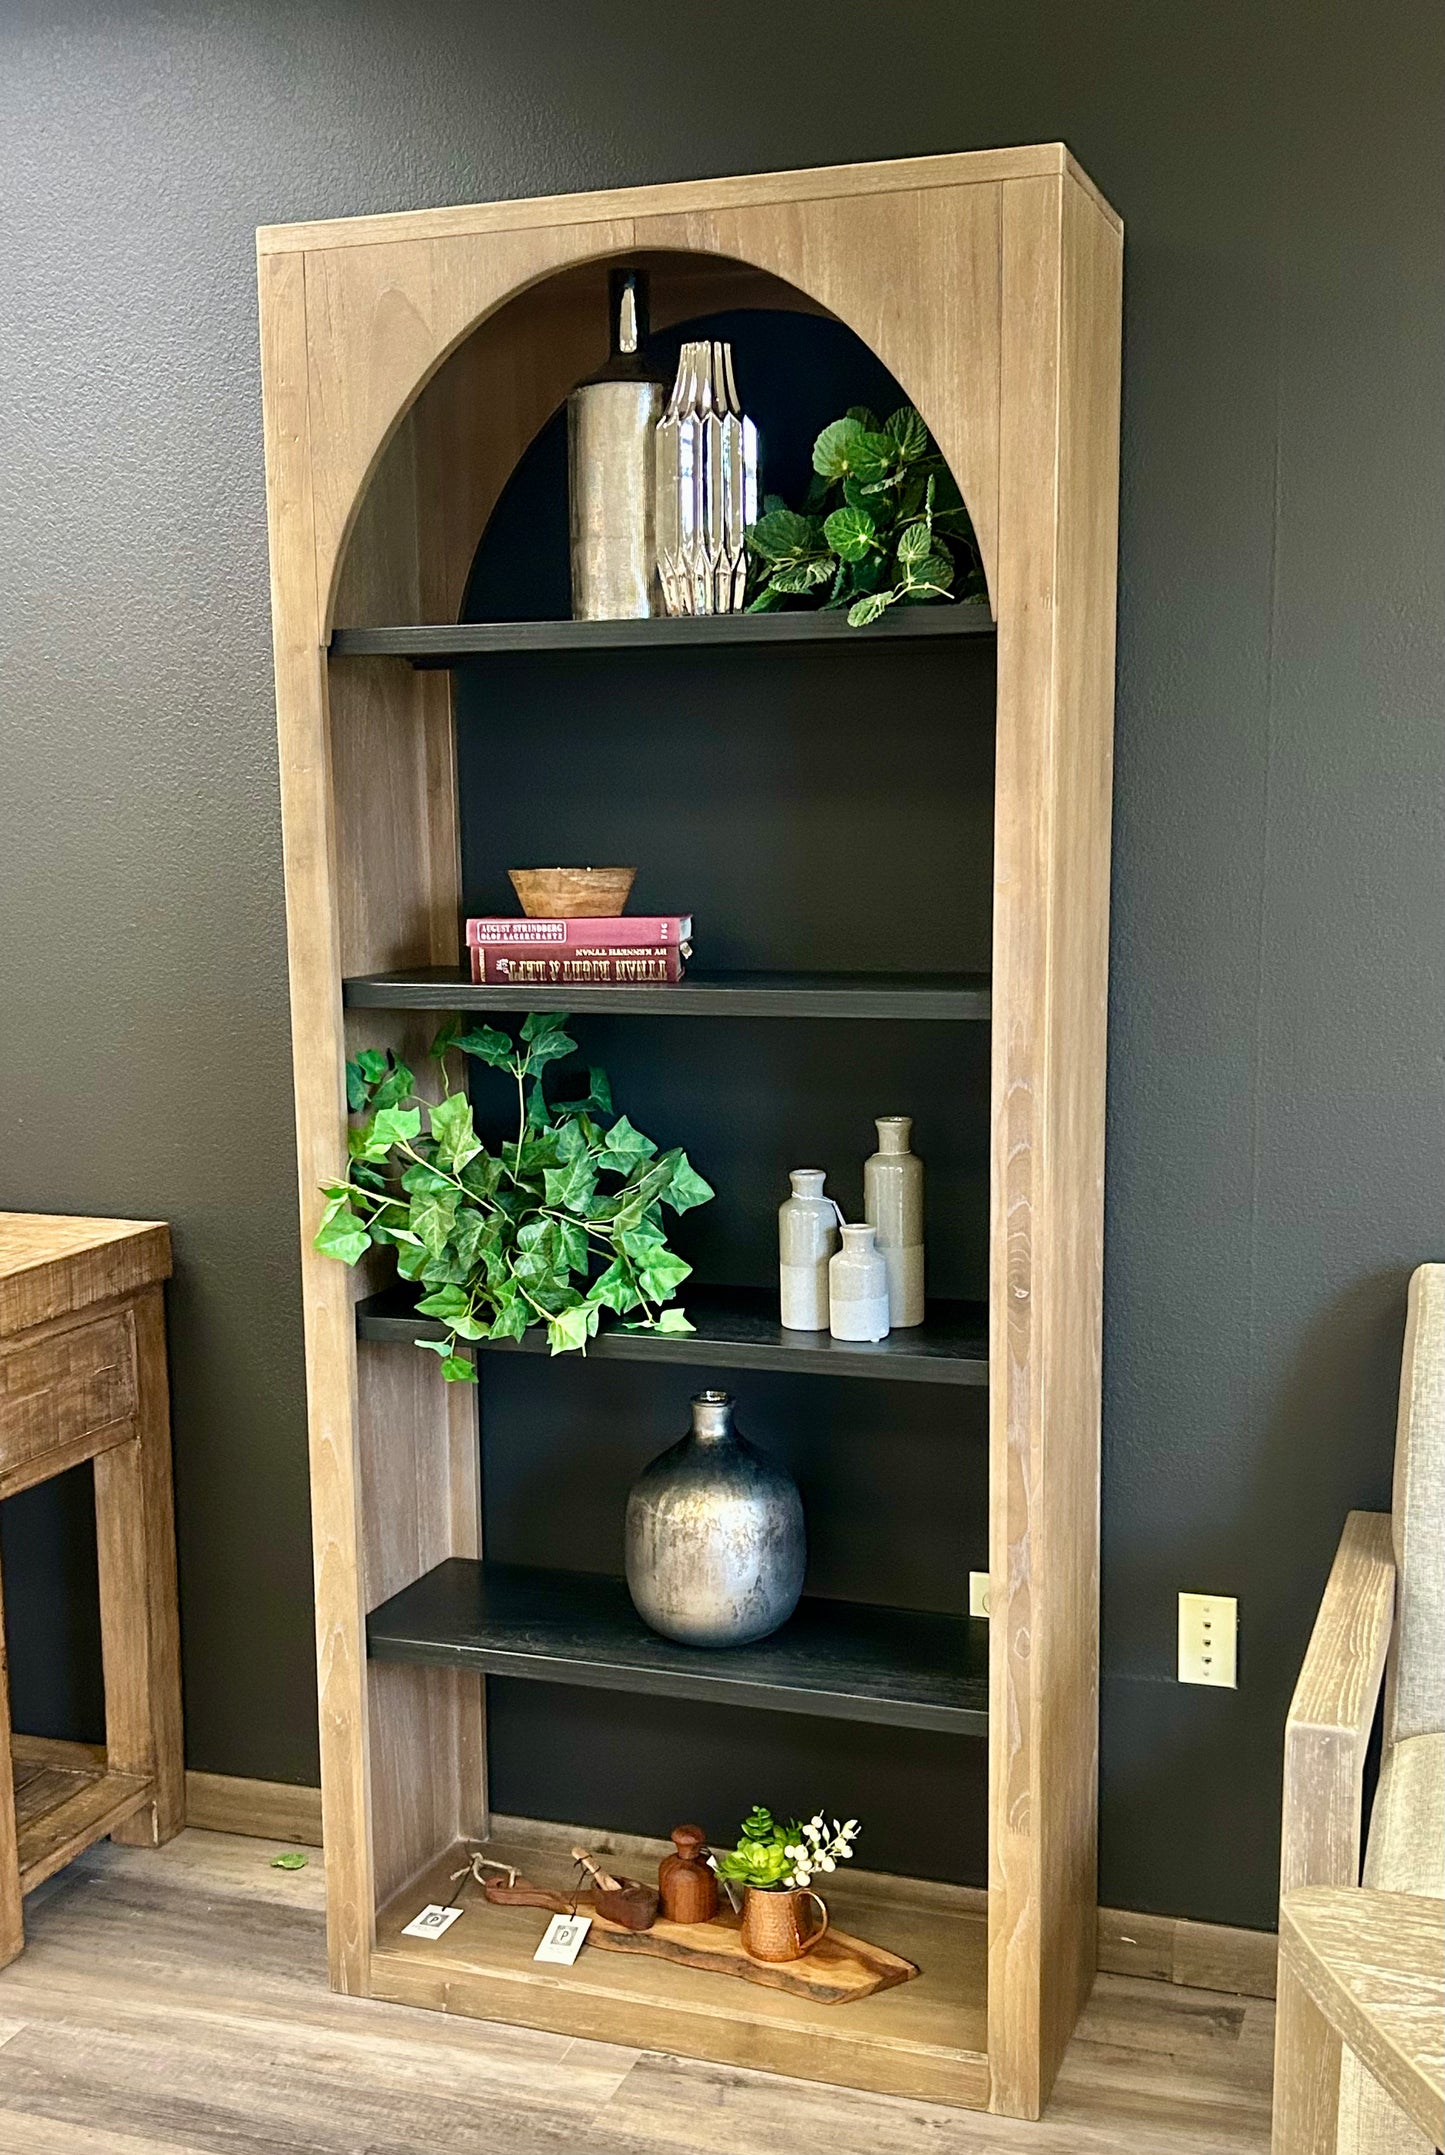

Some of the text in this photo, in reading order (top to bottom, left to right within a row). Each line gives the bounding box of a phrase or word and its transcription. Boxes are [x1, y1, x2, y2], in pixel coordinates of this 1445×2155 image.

[481, 924, 563, 933] AUGUST STRINDBERG
[575, 948, 667, 957] BY KENNETH TYNAN
[508, 960, 547, 982] LEFT
[549, 960, 560, 981] &
[563, 960, 611, 981] RIGHT
[616, 960, 668, 981] TYNAN
[560, 1930, 569, 1941] P
